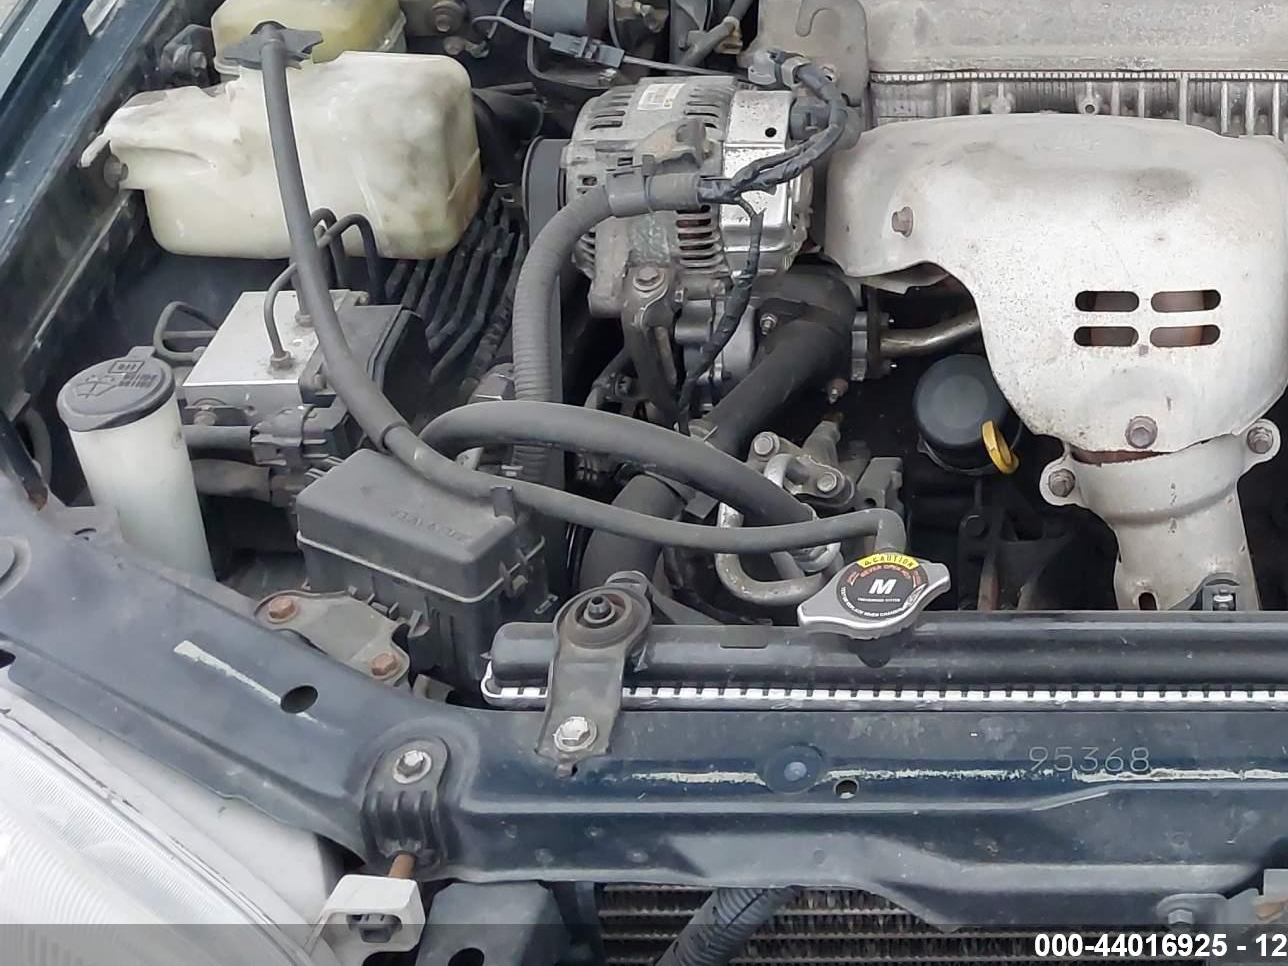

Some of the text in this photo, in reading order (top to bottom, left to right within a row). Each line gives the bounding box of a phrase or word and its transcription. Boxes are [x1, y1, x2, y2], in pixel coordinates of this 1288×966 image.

[872, 554, 914, 568] CAUTION
[868, 578, 897, 595] M
[1028, 746, 1150, 772] 95368
